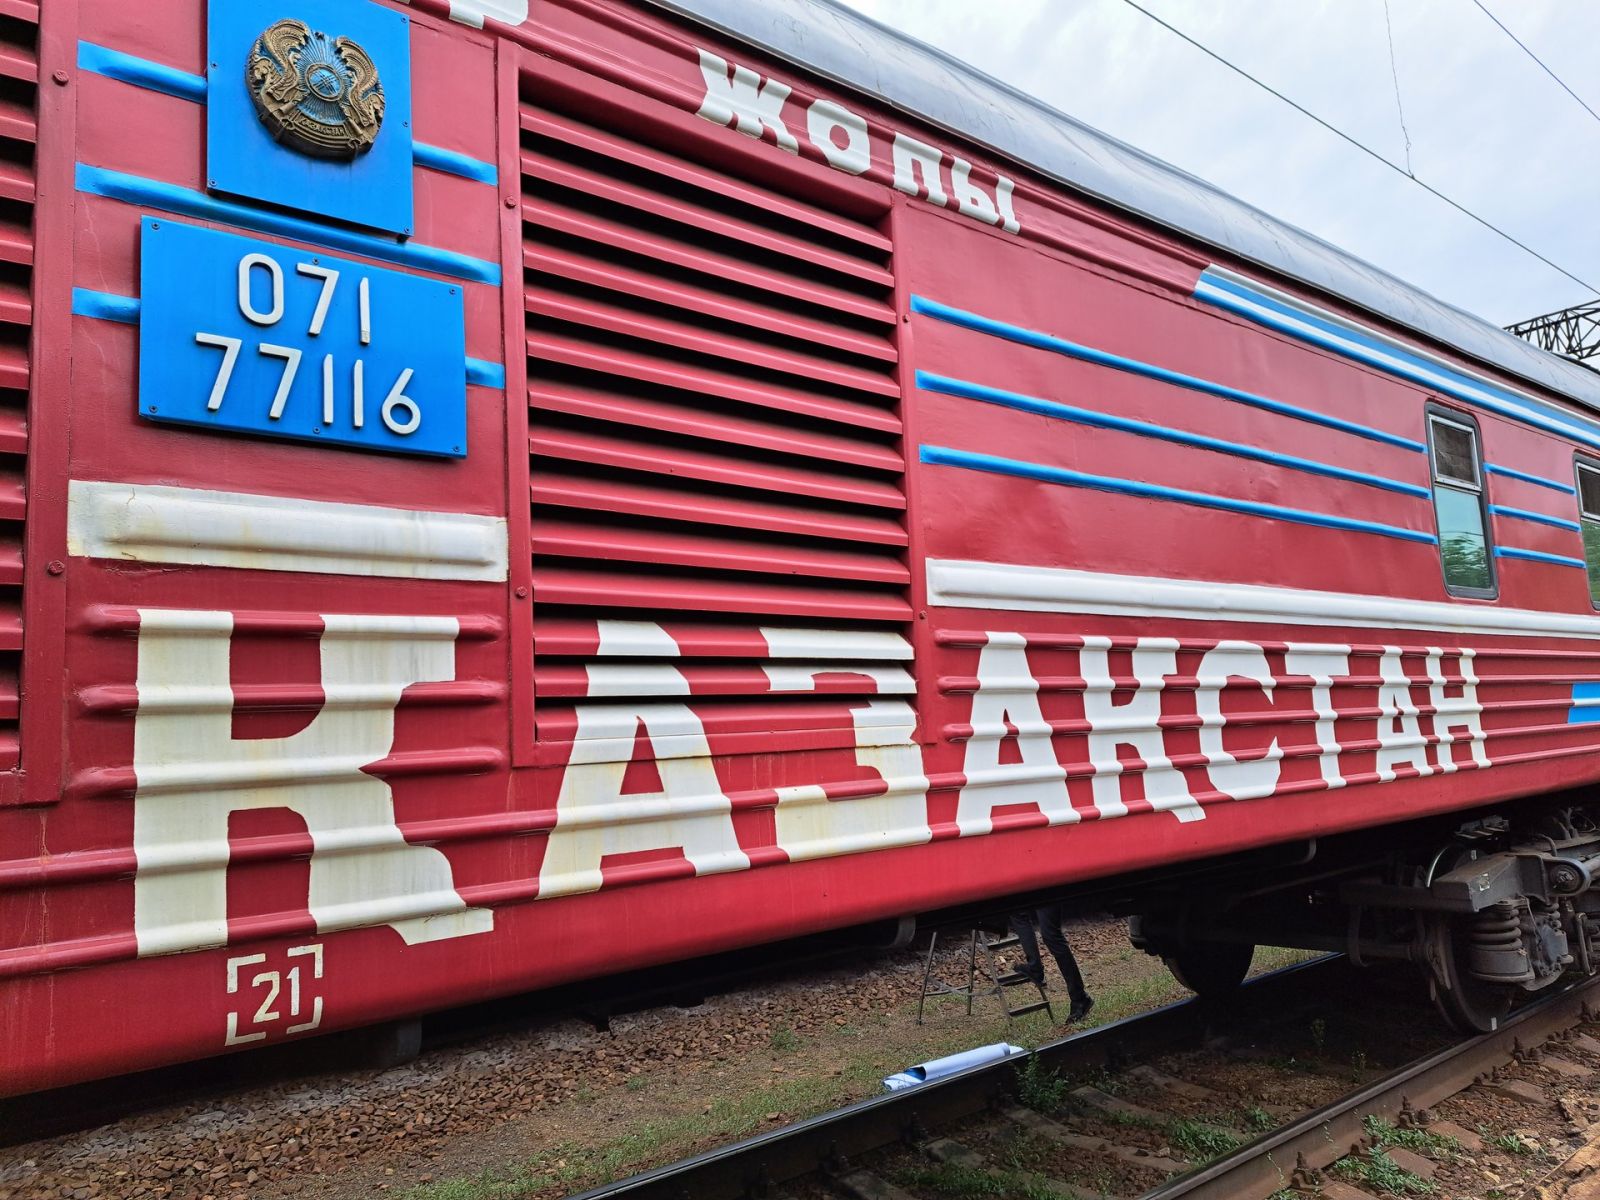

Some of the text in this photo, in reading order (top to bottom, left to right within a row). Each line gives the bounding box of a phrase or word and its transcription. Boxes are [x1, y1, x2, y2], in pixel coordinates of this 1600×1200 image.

[238, 253, 370, 344] 071
[195, 332, 421, 435] 77116
[252, 966, 300, 1023] 21
